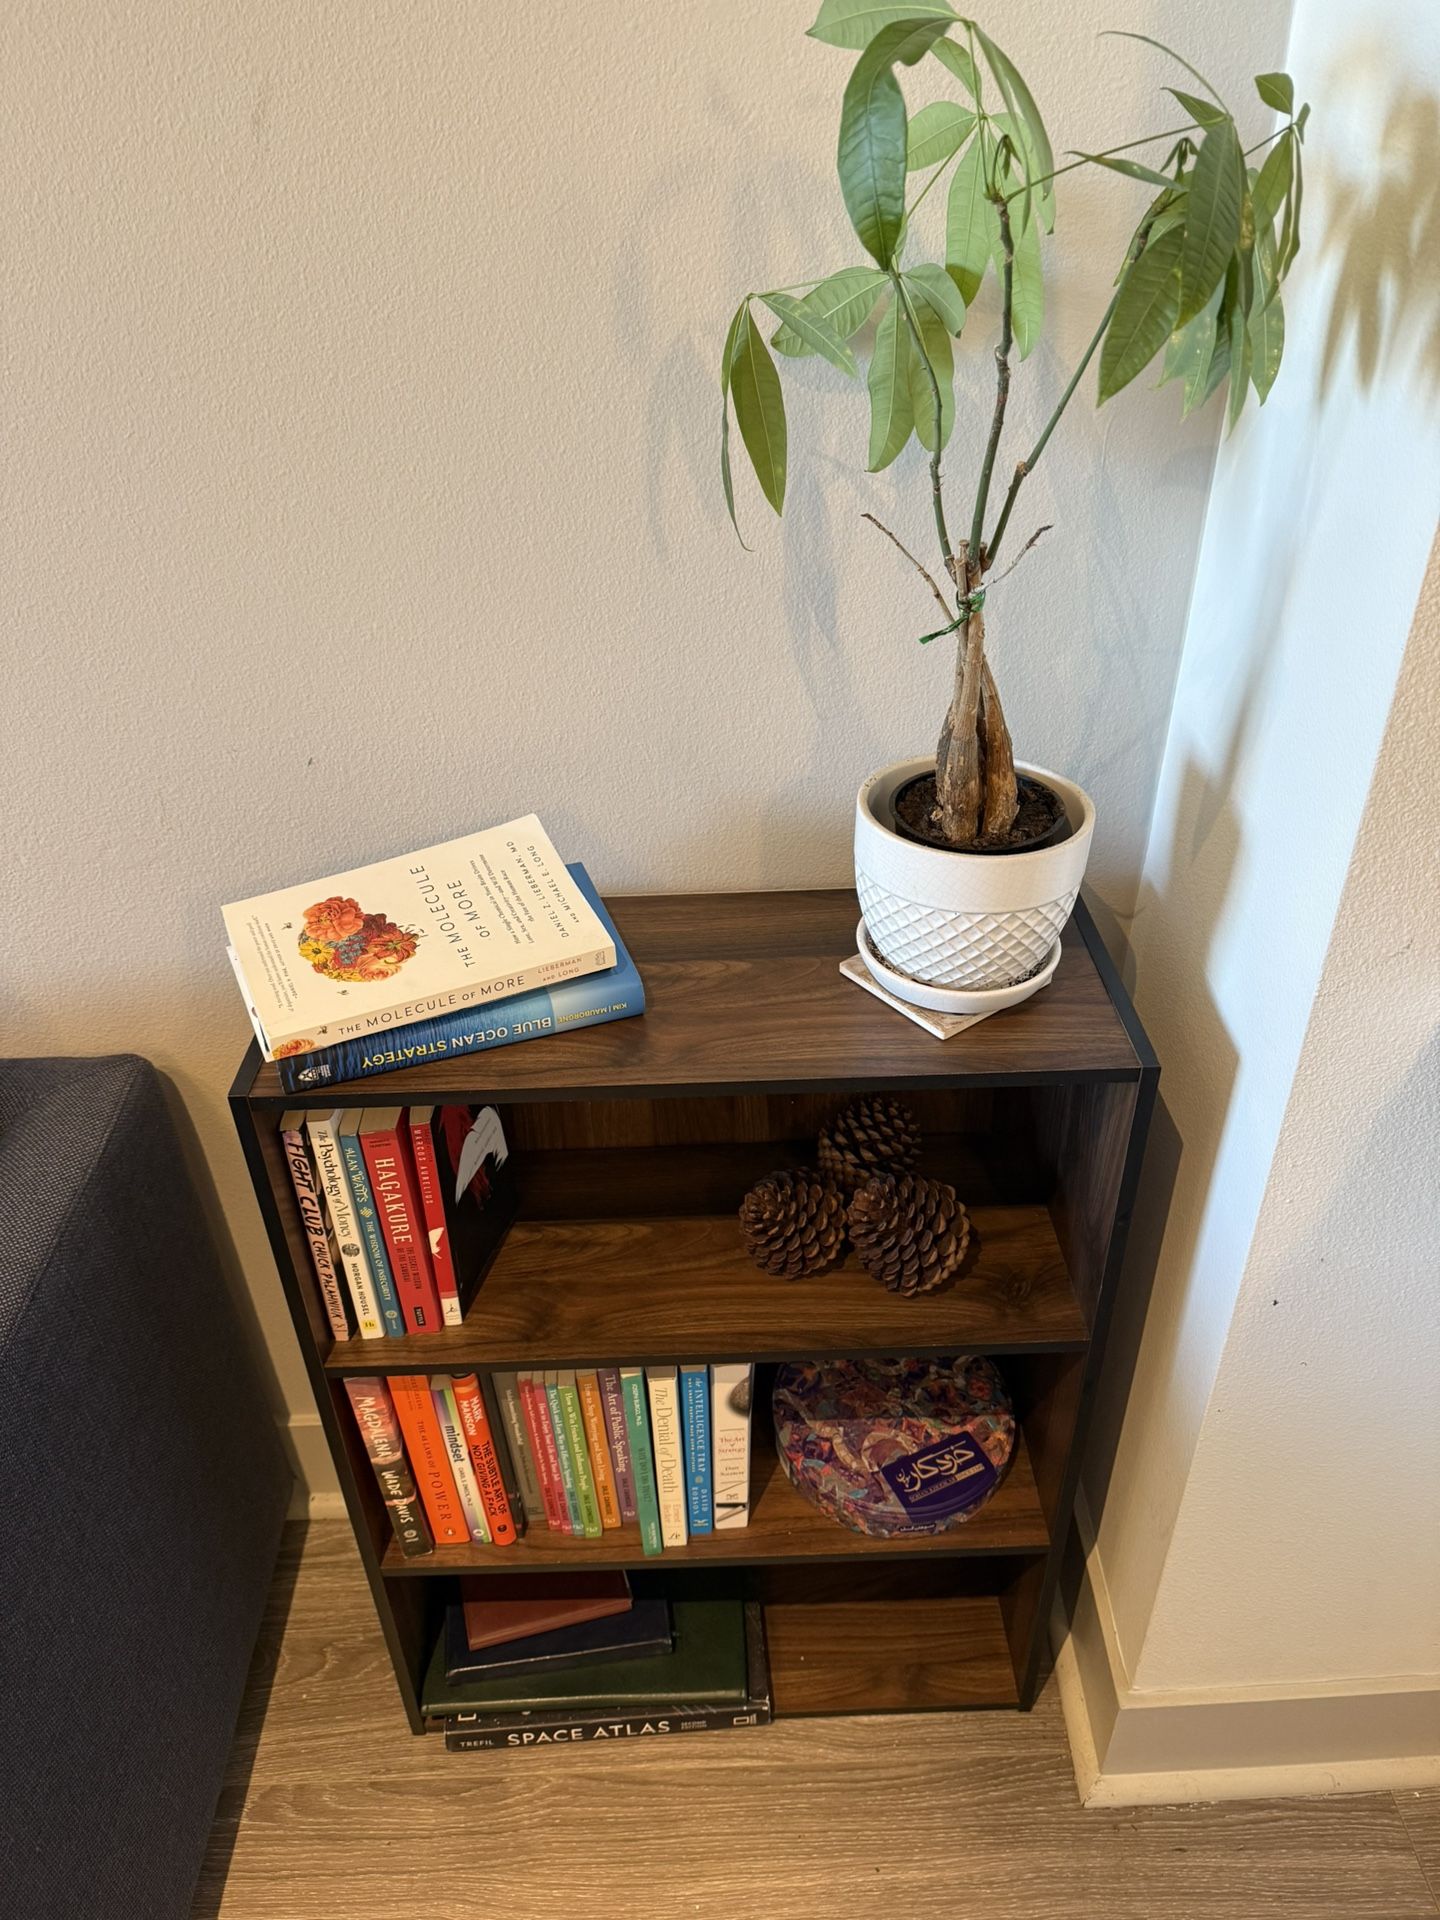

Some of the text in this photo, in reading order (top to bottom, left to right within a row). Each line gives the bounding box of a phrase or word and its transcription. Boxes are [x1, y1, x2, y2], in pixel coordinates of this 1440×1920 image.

[506, 841, 517, 853] MD
[527, 846, 544, 867] LONG
[516, 855, 545, 900] LIEBERMAN,
[447, 880, 490, 938] OF MORE
[547, 879, 570, 910] MICHAEL
[410, 866, 475, 967] THE MOLECULE
[548, 911, 569, 937] DANIEL
[538, 958, 581, 973] LIEBERMAN
[558, 968, 579, 977] LONG
[338, 976, 524, 1034] THE MOLECULE OF MORE
[363, 1017, 551, 1068] BLUE OCEAN STRATEGY
[317, 1130, 328, 1142] The
[412, 1129, 427, 1161] MARCUS
[316, 1143, 343, 1198] Psychology
[345, 1148, 368, 1202] ALAN WATTS
[418, 1166, 435, 1204] AURELIUS
[286, 1139, 323, 1236] FIGHT CLUB
[375, 1158, 412, 1244] HAGAKURE
[333, 1204, 353, 1238] Money
[366, 1221, 391, 1300] THE WISDOM OF INSECURITY
[313, 1241, 342, 1318] CHUCK PALAHNIUK
[351, 1263, 369, 1315] MORGAN HOUSEL
[565, 1393, 573, 1405] How
[584, 1383, 592, 1396] How
[461, 1401, 476, 1435] MANSON
[470, 1396, 483, 1422] MARK
[587, 1404, 595, 1416] Stop
[605, 1375, 628, 1472] The Art of Public Speaking
[694, 1390, 706, 1450] INTELLIGENCE
[355, 1397, 395, 1460] MAGDALENA
[417, 1421, 425, 1433] THE
[571, 1425, 580, 1442] Friends
[589, 1417, 599, 1441] Worrying
[655, 1388, 678, 1493] The Denial of Death
[423, 1443, 432, 1459] LAWS
[444, 1424, 466, 1463] mindset
[472, 1445, 483, 1460] NOT
[574, 1444, 582, 1452] and
[593, 1442, 602, 1451] and
[595, 1452, 603, 1464] Start
[428, 1460, 435, 1468] OF
[477, 1463, 490, 1488] GIVING
[482, 1440, 507, 1514] THE SUBTLE ART OF
[575, 1453, 585, 1474] Influence
[597, 1464, 606, 1481] Living
[381, 1469, 413, 1523] WADE DAVIS
[428, 1472, 452, 1520] POWER
[579, 1475, 588, 1490] People
[508, 1721, 670, 1745] SPACE ATLAS
